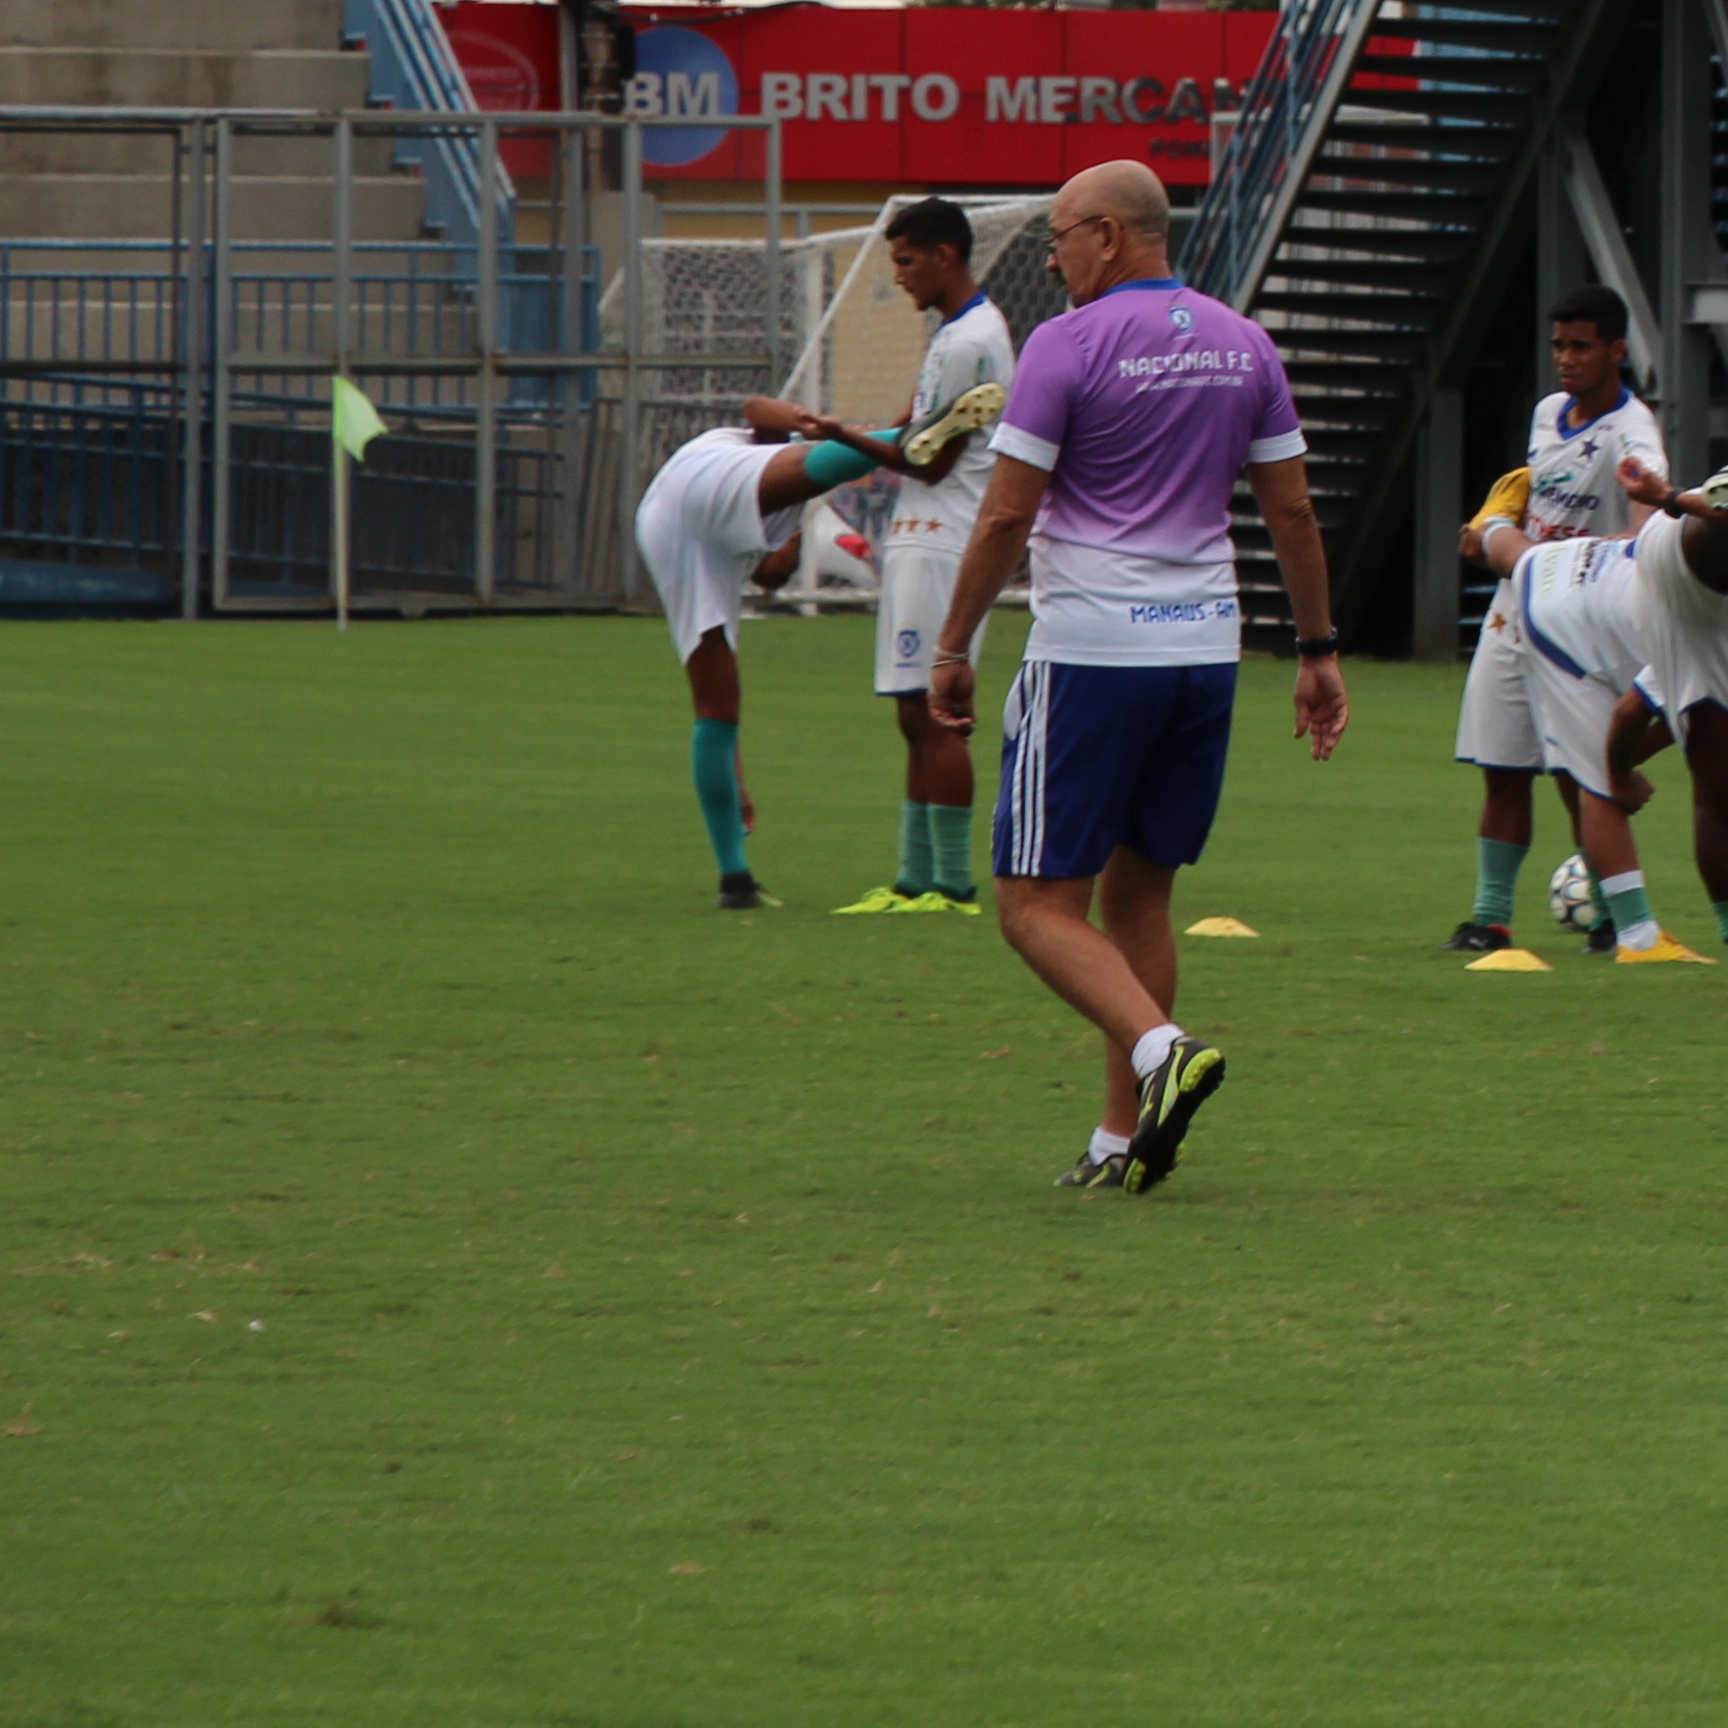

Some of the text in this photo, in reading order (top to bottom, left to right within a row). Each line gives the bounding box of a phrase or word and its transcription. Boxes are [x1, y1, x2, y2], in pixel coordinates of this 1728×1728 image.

[623, 71, 720, 117] BM
[761, 72, 961, 122] BRITO
[1118, 349, 1223, 378] NACIONAL
